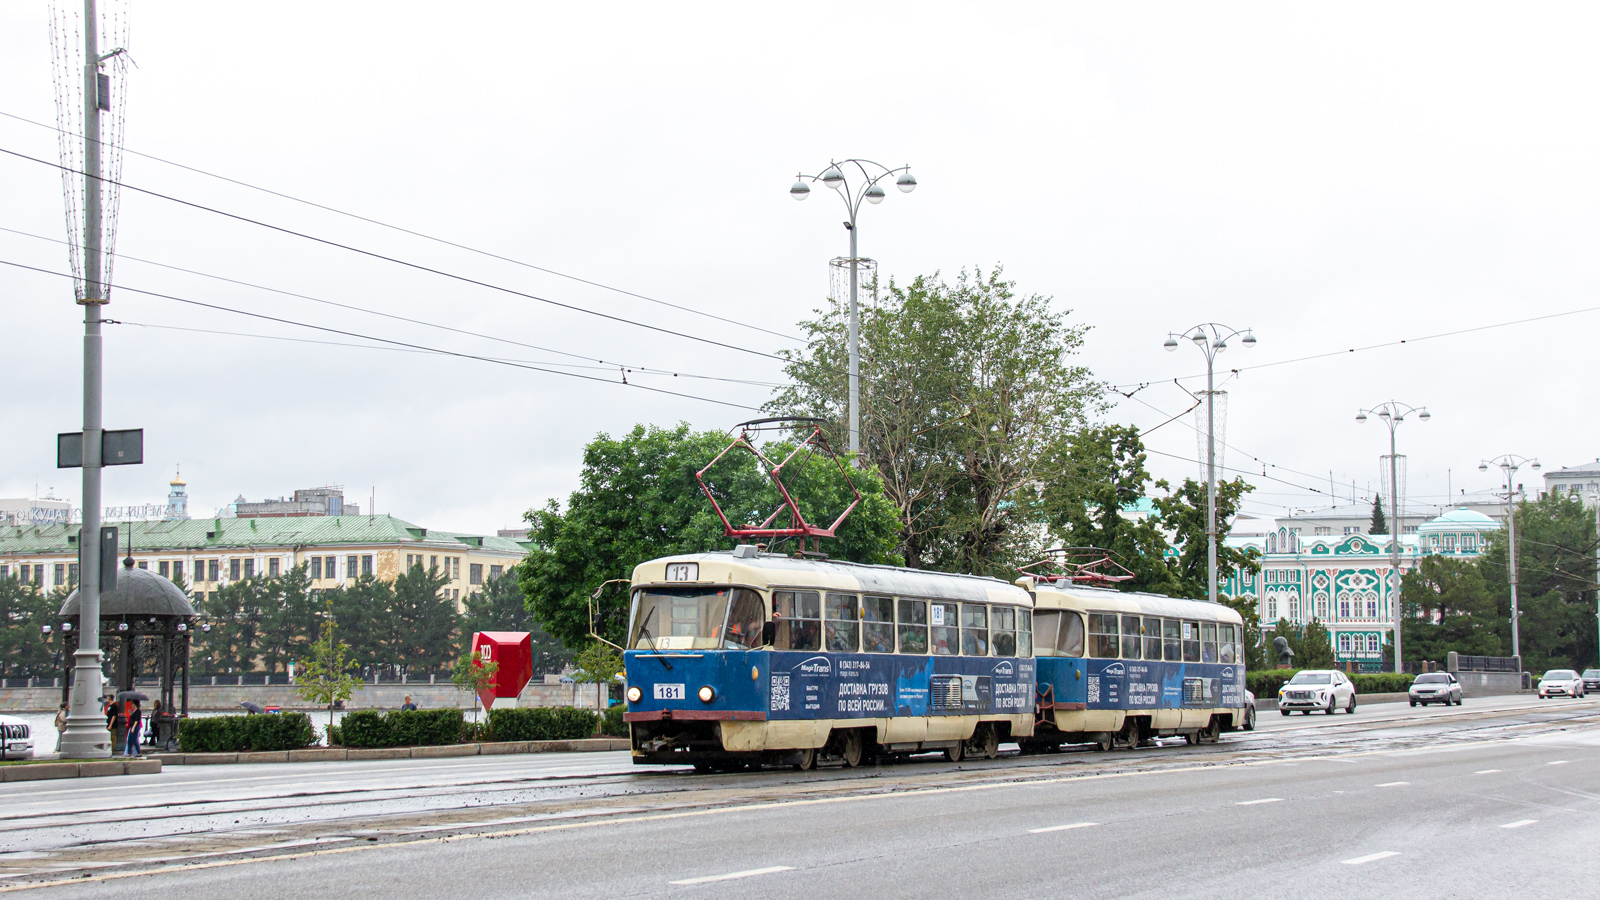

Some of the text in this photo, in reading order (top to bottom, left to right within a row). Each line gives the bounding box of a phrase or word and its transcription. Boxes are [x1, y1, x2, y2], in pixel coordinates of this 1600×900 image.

[15, 508, 66, 522] ОТКУДА,
[673, 566, 689, 581] 13
[933, 606, 943, 619] 181
[659, 637, 671, 649] 13
[800, 663, 829, 673] MagicTrans
[658, 687, 679, 698] 181
[838, 683, 889, 698] ДОСТАВКА ГРУЗОВ
[838, 697, 885, 712] ПО ВСЕЙ РОССИИ
